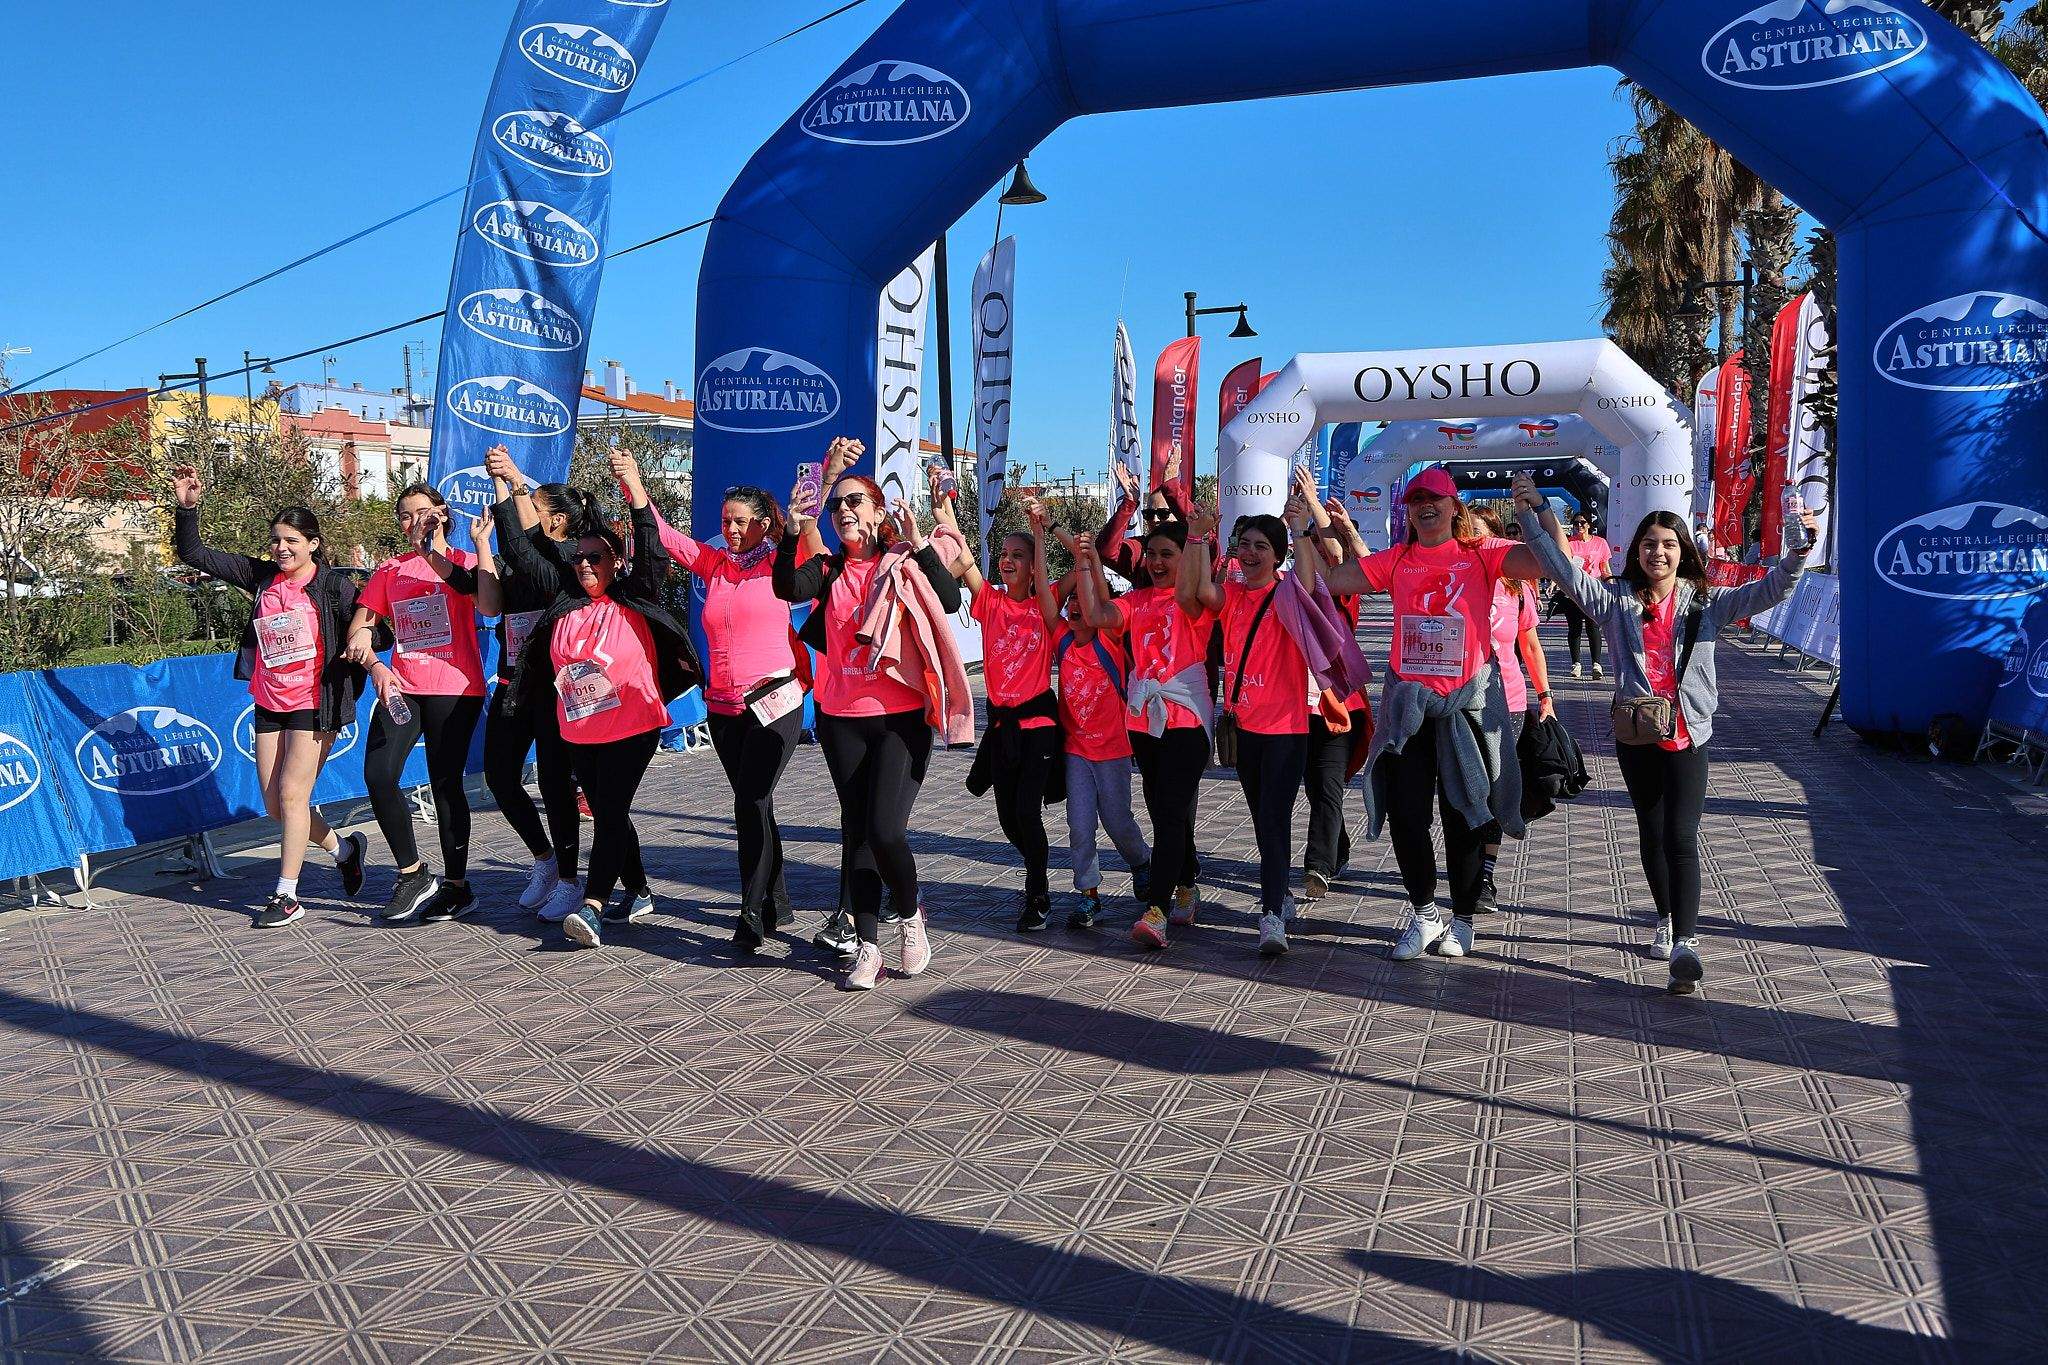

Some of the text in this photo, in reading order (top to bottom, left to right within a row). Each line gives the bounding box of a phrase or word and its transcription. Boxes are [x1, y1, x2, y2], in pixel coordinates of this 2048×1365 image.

[1751, 16, 1902, 42] CENTRAL LECHERA
[526, 32, 628, 87] ASTURIANA
[551, 36, 631, 70] CENTRAL LECHERA
[1719, 28, 1915, 75] ASTURIANA
[836, 86, 951, 101] CENTRAL LECHERA
[808, 99, 957, 128] ASTURIANA
[500, 120, 605, 170] ASTURIANA
[481, 210, 588, 260] ASTURIANA
[467, 300, 573, 345] ASTURIANA
[1918, 322, 2048, 340] CENTRAL LECHE
[1886, 334, 2048, 371] ASTURIAN
[714, 376, 824, 388] CENTRAL LECHERA
[1354, 358, 1541, 403] OYSHO
[476, 390, 559, 412] CENTRAL LECHERA
[700, 380, 829, 414] ASTURIANA
[1597, 395, 1656, 410] OYSHO
[455, 389, 561, 430] ASTURIANA
[1247, 411, 1301, 424] OYSHO
[1466, 468, 1554, 480] VOLVO
[1630, 473, 1685, 487] OYSHO
[465, 481, 496, 490] CENTR
[1224, 484, 1272, 497] OYSHO
[1919, 535, 1991, 547] CENTRAL
[1887, 539, 2048, 576] ASTURIAN
[412, 619, 432, 631] 016
[275, 633, 295, 646] 016
[1420, 642, 1444, 653] 016
[575, 683, 596, 697] 016
